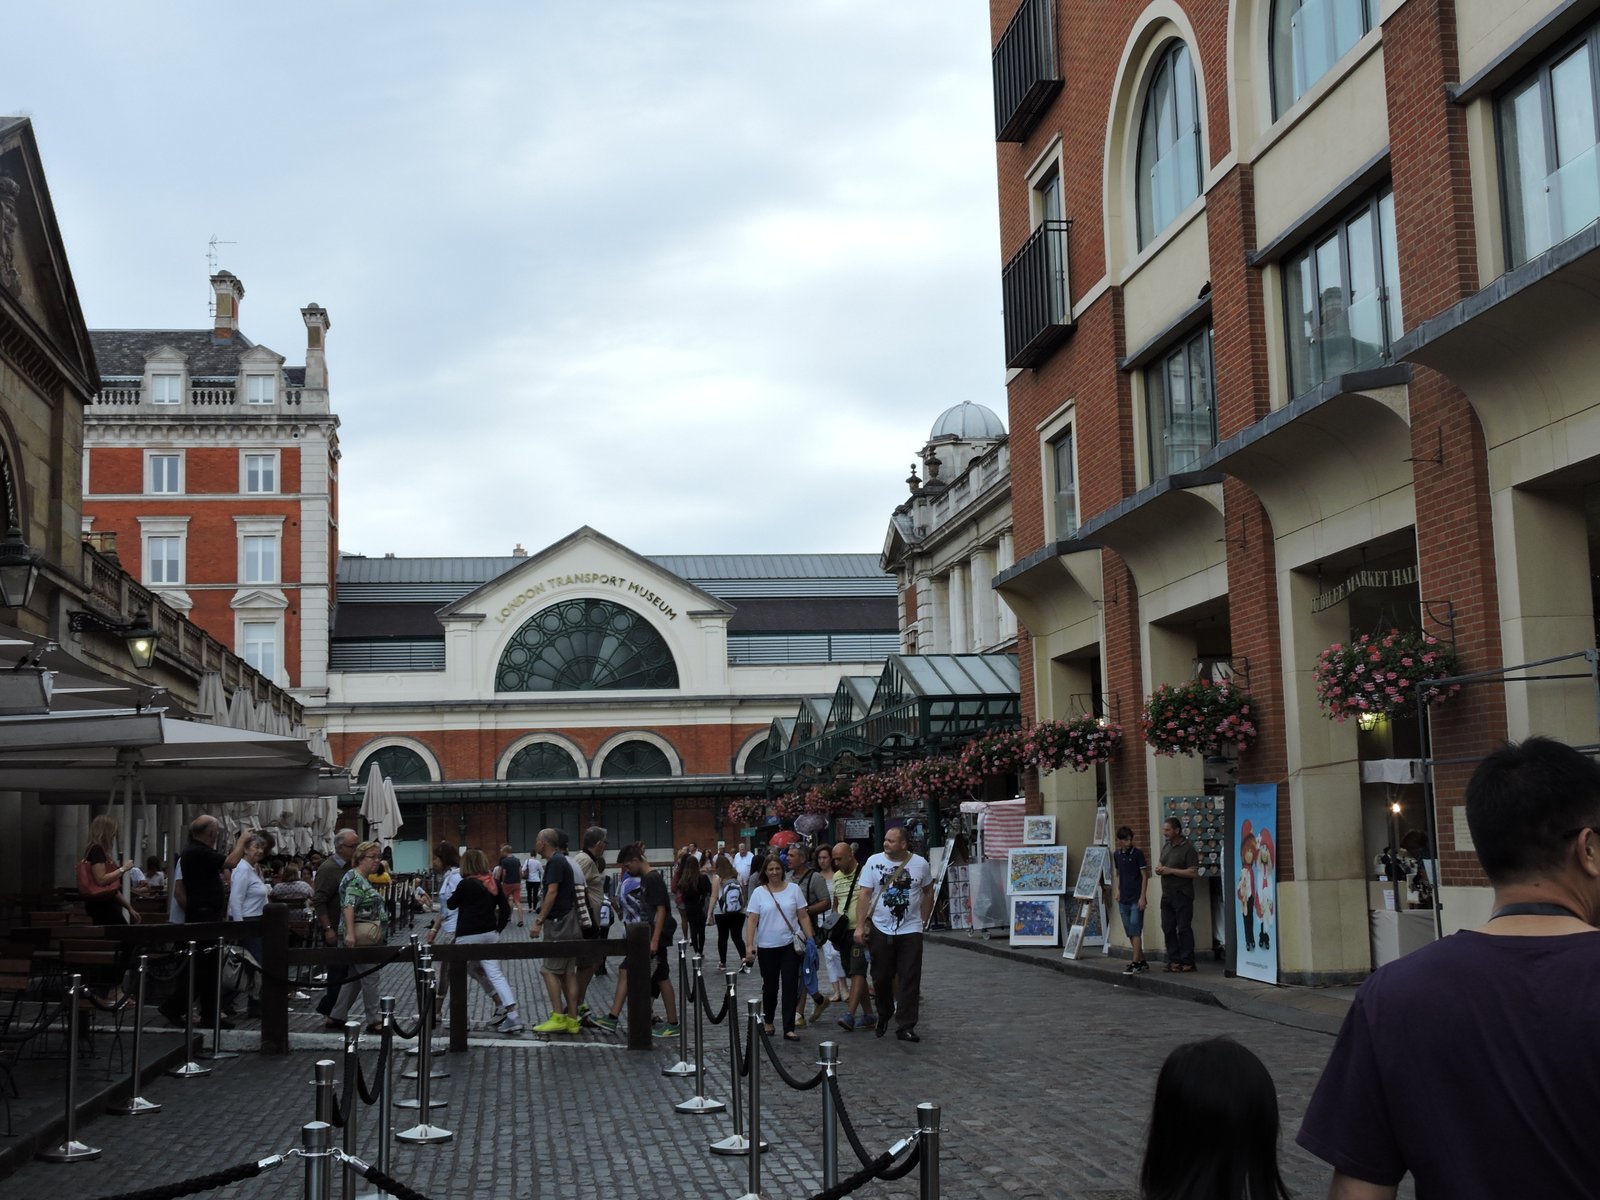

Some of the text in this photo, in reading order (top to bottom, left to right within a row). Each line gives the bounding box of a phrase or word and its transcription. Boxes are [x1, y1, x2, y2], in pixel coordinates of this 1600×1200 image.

[495, 573, 677, 624] LONDON TRANSPORT MUSEUM
[1346, 570, 1389, 594] MARKET
